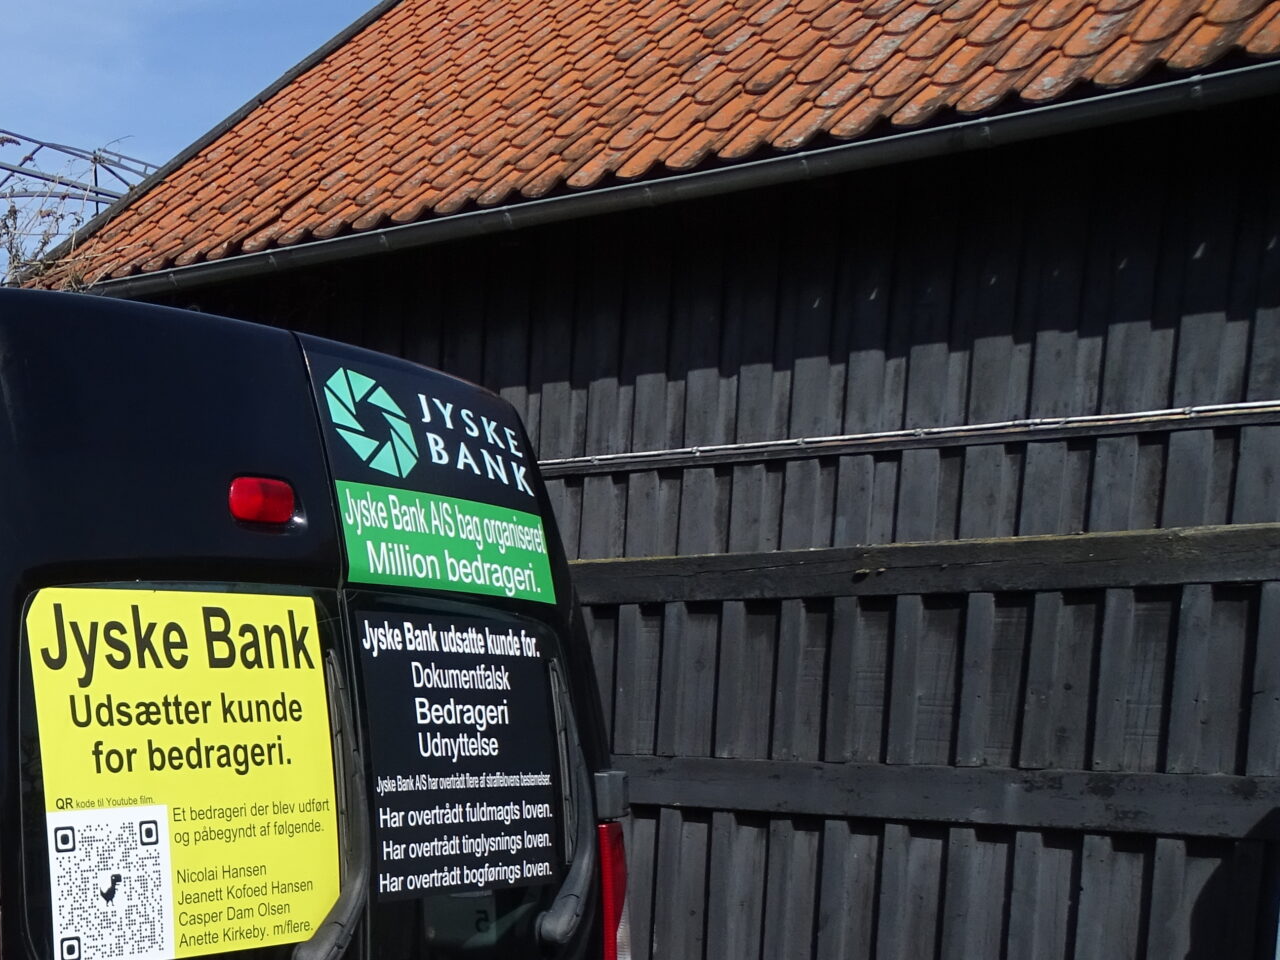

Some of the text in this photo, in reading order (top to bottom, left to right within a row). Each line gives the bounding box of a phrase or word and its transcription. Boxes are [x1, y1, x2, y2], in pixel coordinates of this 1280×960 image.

[417, 393, 524, 458] JYSKE
[425, 431, 535, 498] BANK
[344, 488, 388, 535] Jyske
[388, 494, 429, 533] Bank
[430, 500, 455, 537] A/S
[454, 504, 483, 550] bag
[366, 540, 541, 597] Million bedrageri.
[40, 602, 315, 688] Jyske Bank
[362, 619, 540, 657] Jyske Bank udsatte kunde for.
[411, 661, 510, 690] Dokumentfalsk
[69, 691, 302, 727] Udsætter kunde
[414, 697, 508, 731] Bedrageri
[91, 734, 291, 775] for bedrageri.
[418, 731, 498, 762] Udnyttelse
[55, 797, 73, 809] QR
[75, 799, 95, 808] kode
[105, 796, 137, 806] Youtube
[139, 795, 155, 804] film.
[172, 798, 329, 821] Et bedrageri der blev udført
[173, 818, 324, 846] og påbegyndt af følgende.
[176, 864, 266, 883] Nicolai Hansen
[177, 880, 313, 905] Jeanett Kofoed Hansen
[178, 902, 290, 926] Casper Dam Olsen
[178, 919, 314, 947] Anette Kirkeby. m/flere.
